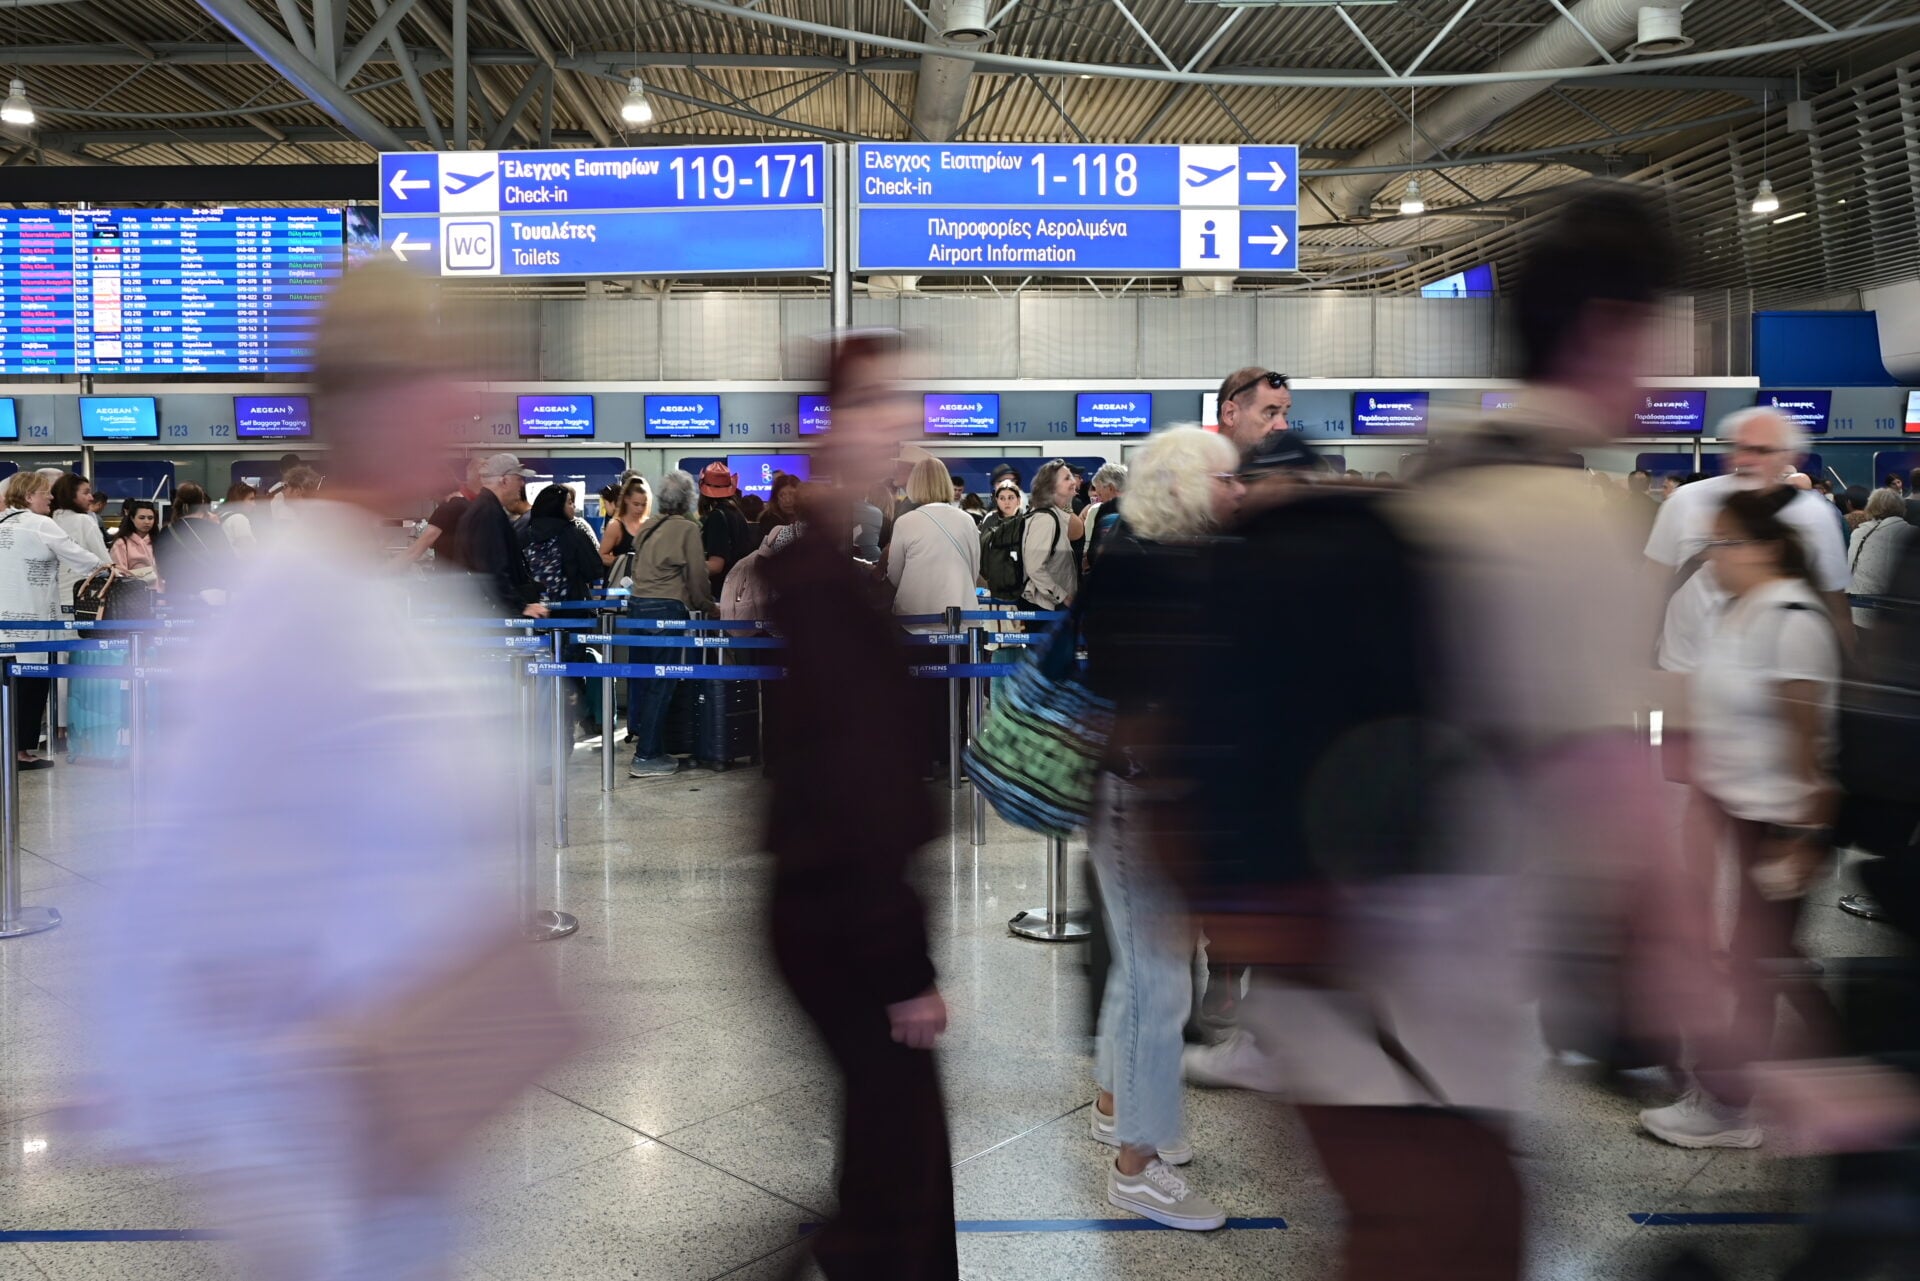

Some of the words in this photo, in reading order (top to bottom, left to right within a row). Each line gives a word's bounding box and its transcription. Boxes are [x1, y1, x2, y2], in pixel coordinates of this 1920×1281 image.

[864, 151, 930, 172] Ελεγχος
[940, 150, 1022, 170] Εισιτηρίων
[500, 160, 570, 181] Έλεγχος
[574, 157, 660, 179] Εισιτηρίων
[1030, 152, 1138, 197] 1-118
[670, 153, 816, 200] 119-171
[865, 176, 932, 196] Check-in
[505, 186, 568, 204] Check-in
[512, 222, 596, 242] Τουαλέτες
[928, 218, 1032, 240] Πληροφορίες
[1036, 218, 1128, 240] Αερολιμένα
[453, 236, 488, 256] WC
[512, 248, 560, 266] Toilets
[928, 244, 984, 264] Airport
[987, 244, 1076, 262] Information
[491, 424, 512, 436] 120
[728, 422, 749, 434] 119
[770, 422, 790, 434] 118
[1006, 421, 1026, 433] 117
[1048, 420, 1068, 432] 116
[1287, 420, 1304, 432] 15
[1324, 420, 1344, 432] 114
[1834, 418, 1853, 430] 111
[1875, 418, 1895, 430] 110
[28, 426, 48, 438] 124
[168, 425, 188, 436] 123
[209, 425, 230, 436] 122
